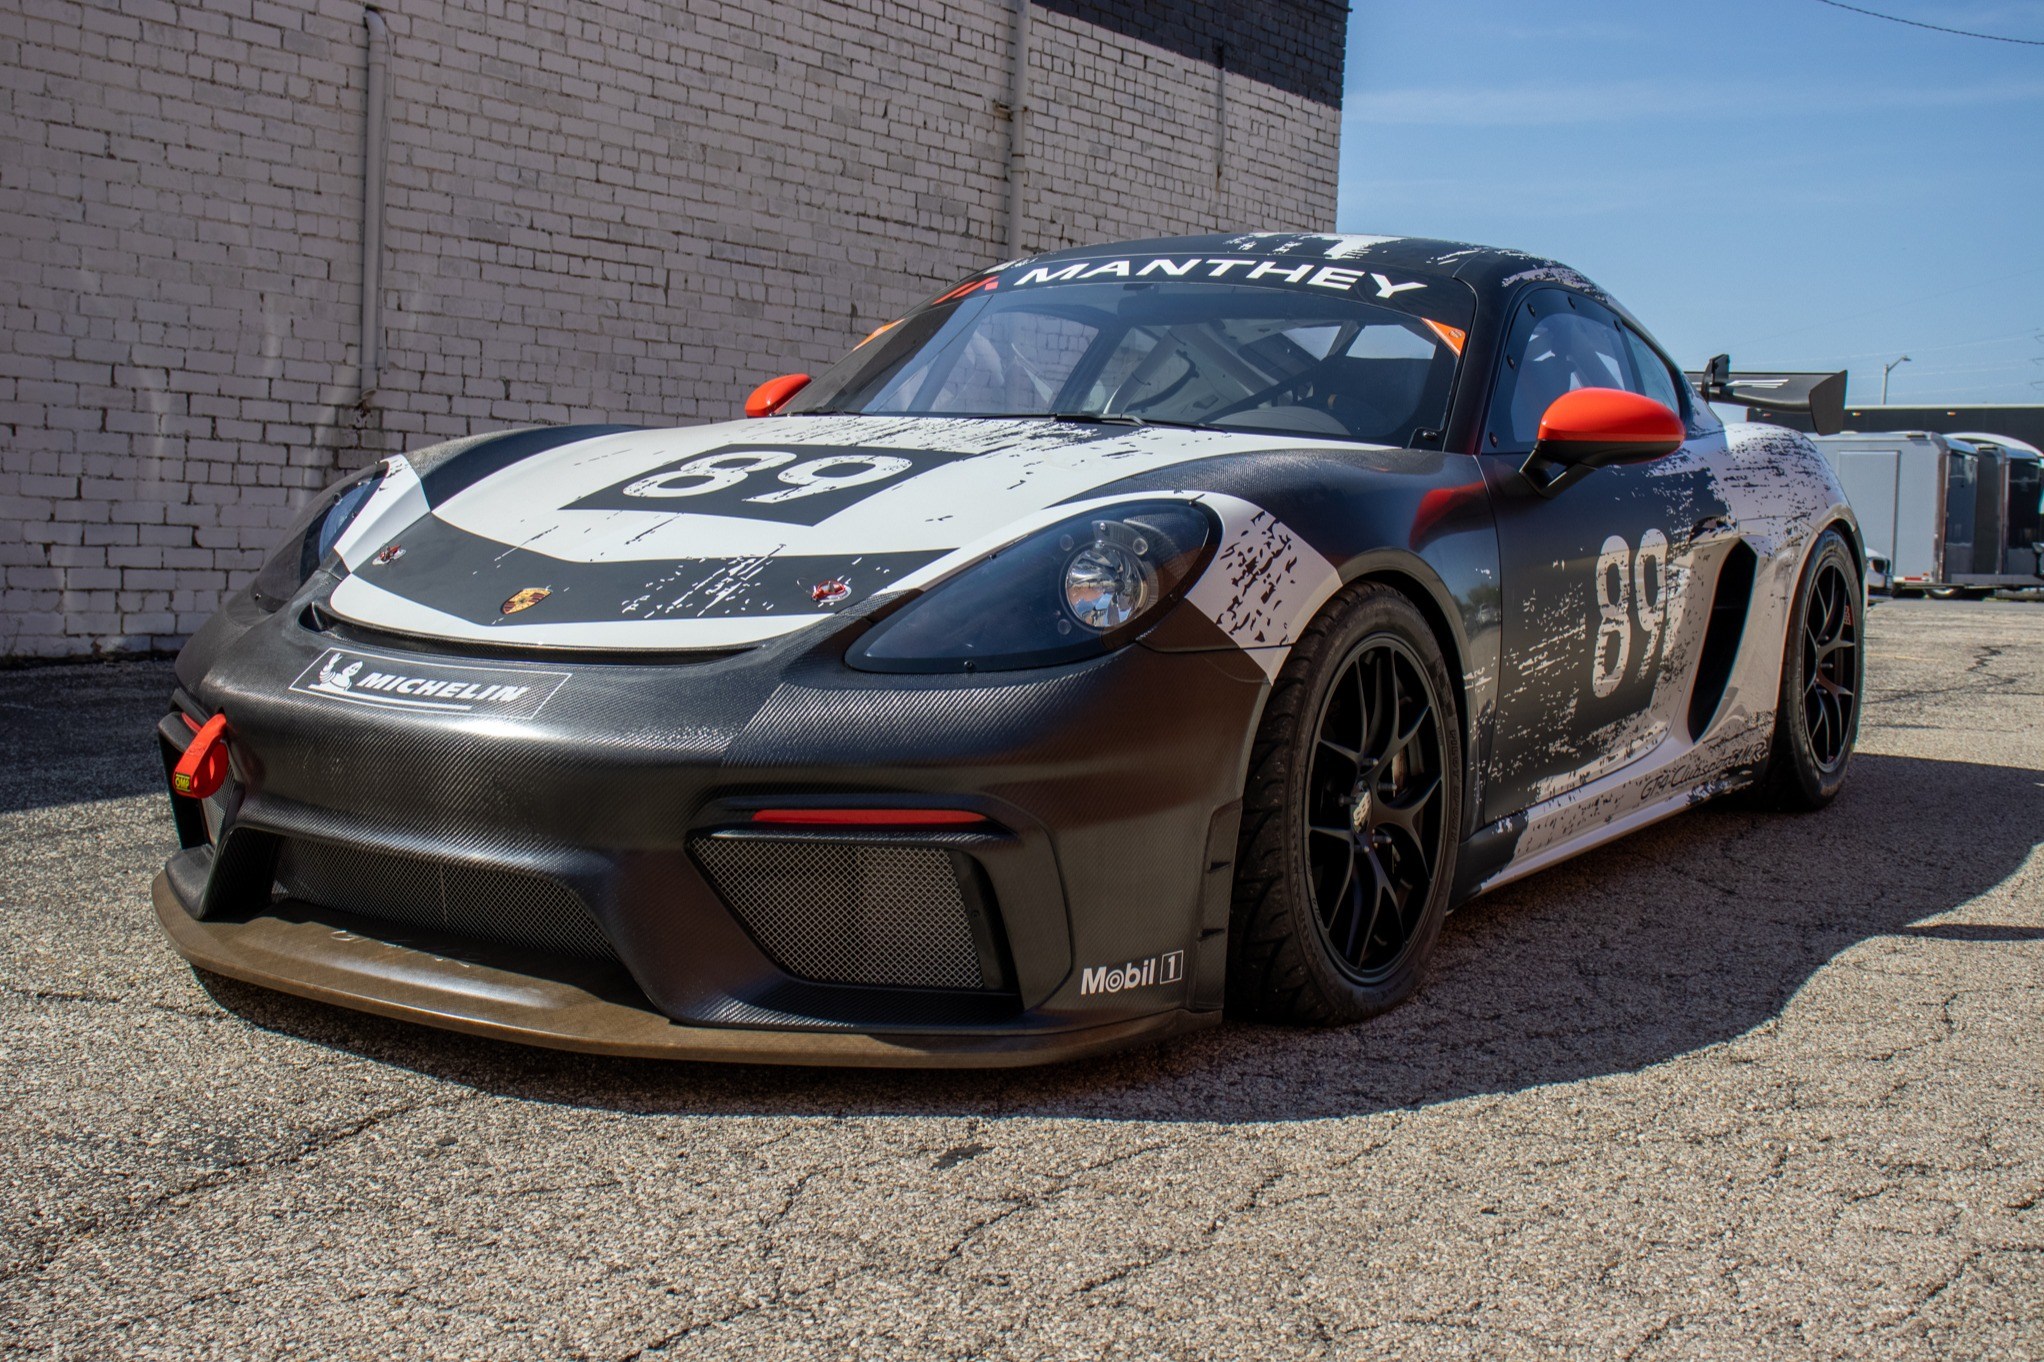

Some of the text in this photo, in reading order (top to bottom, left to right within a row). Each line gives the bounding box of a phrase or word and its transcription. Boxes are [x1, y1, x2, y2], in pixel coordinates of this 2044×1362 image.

[1013, 258, 1428, 299] MANTHEY
[622, 450, 912, 504] 89
[1592, 528, 1668, 698] 89
[356, 672, 530, 702] MICHELIN
[175, 777, 190, 790] OMP
[1640, 774, 1670, 800] GT4
[1080, 958, 1156, 995] Mobil
